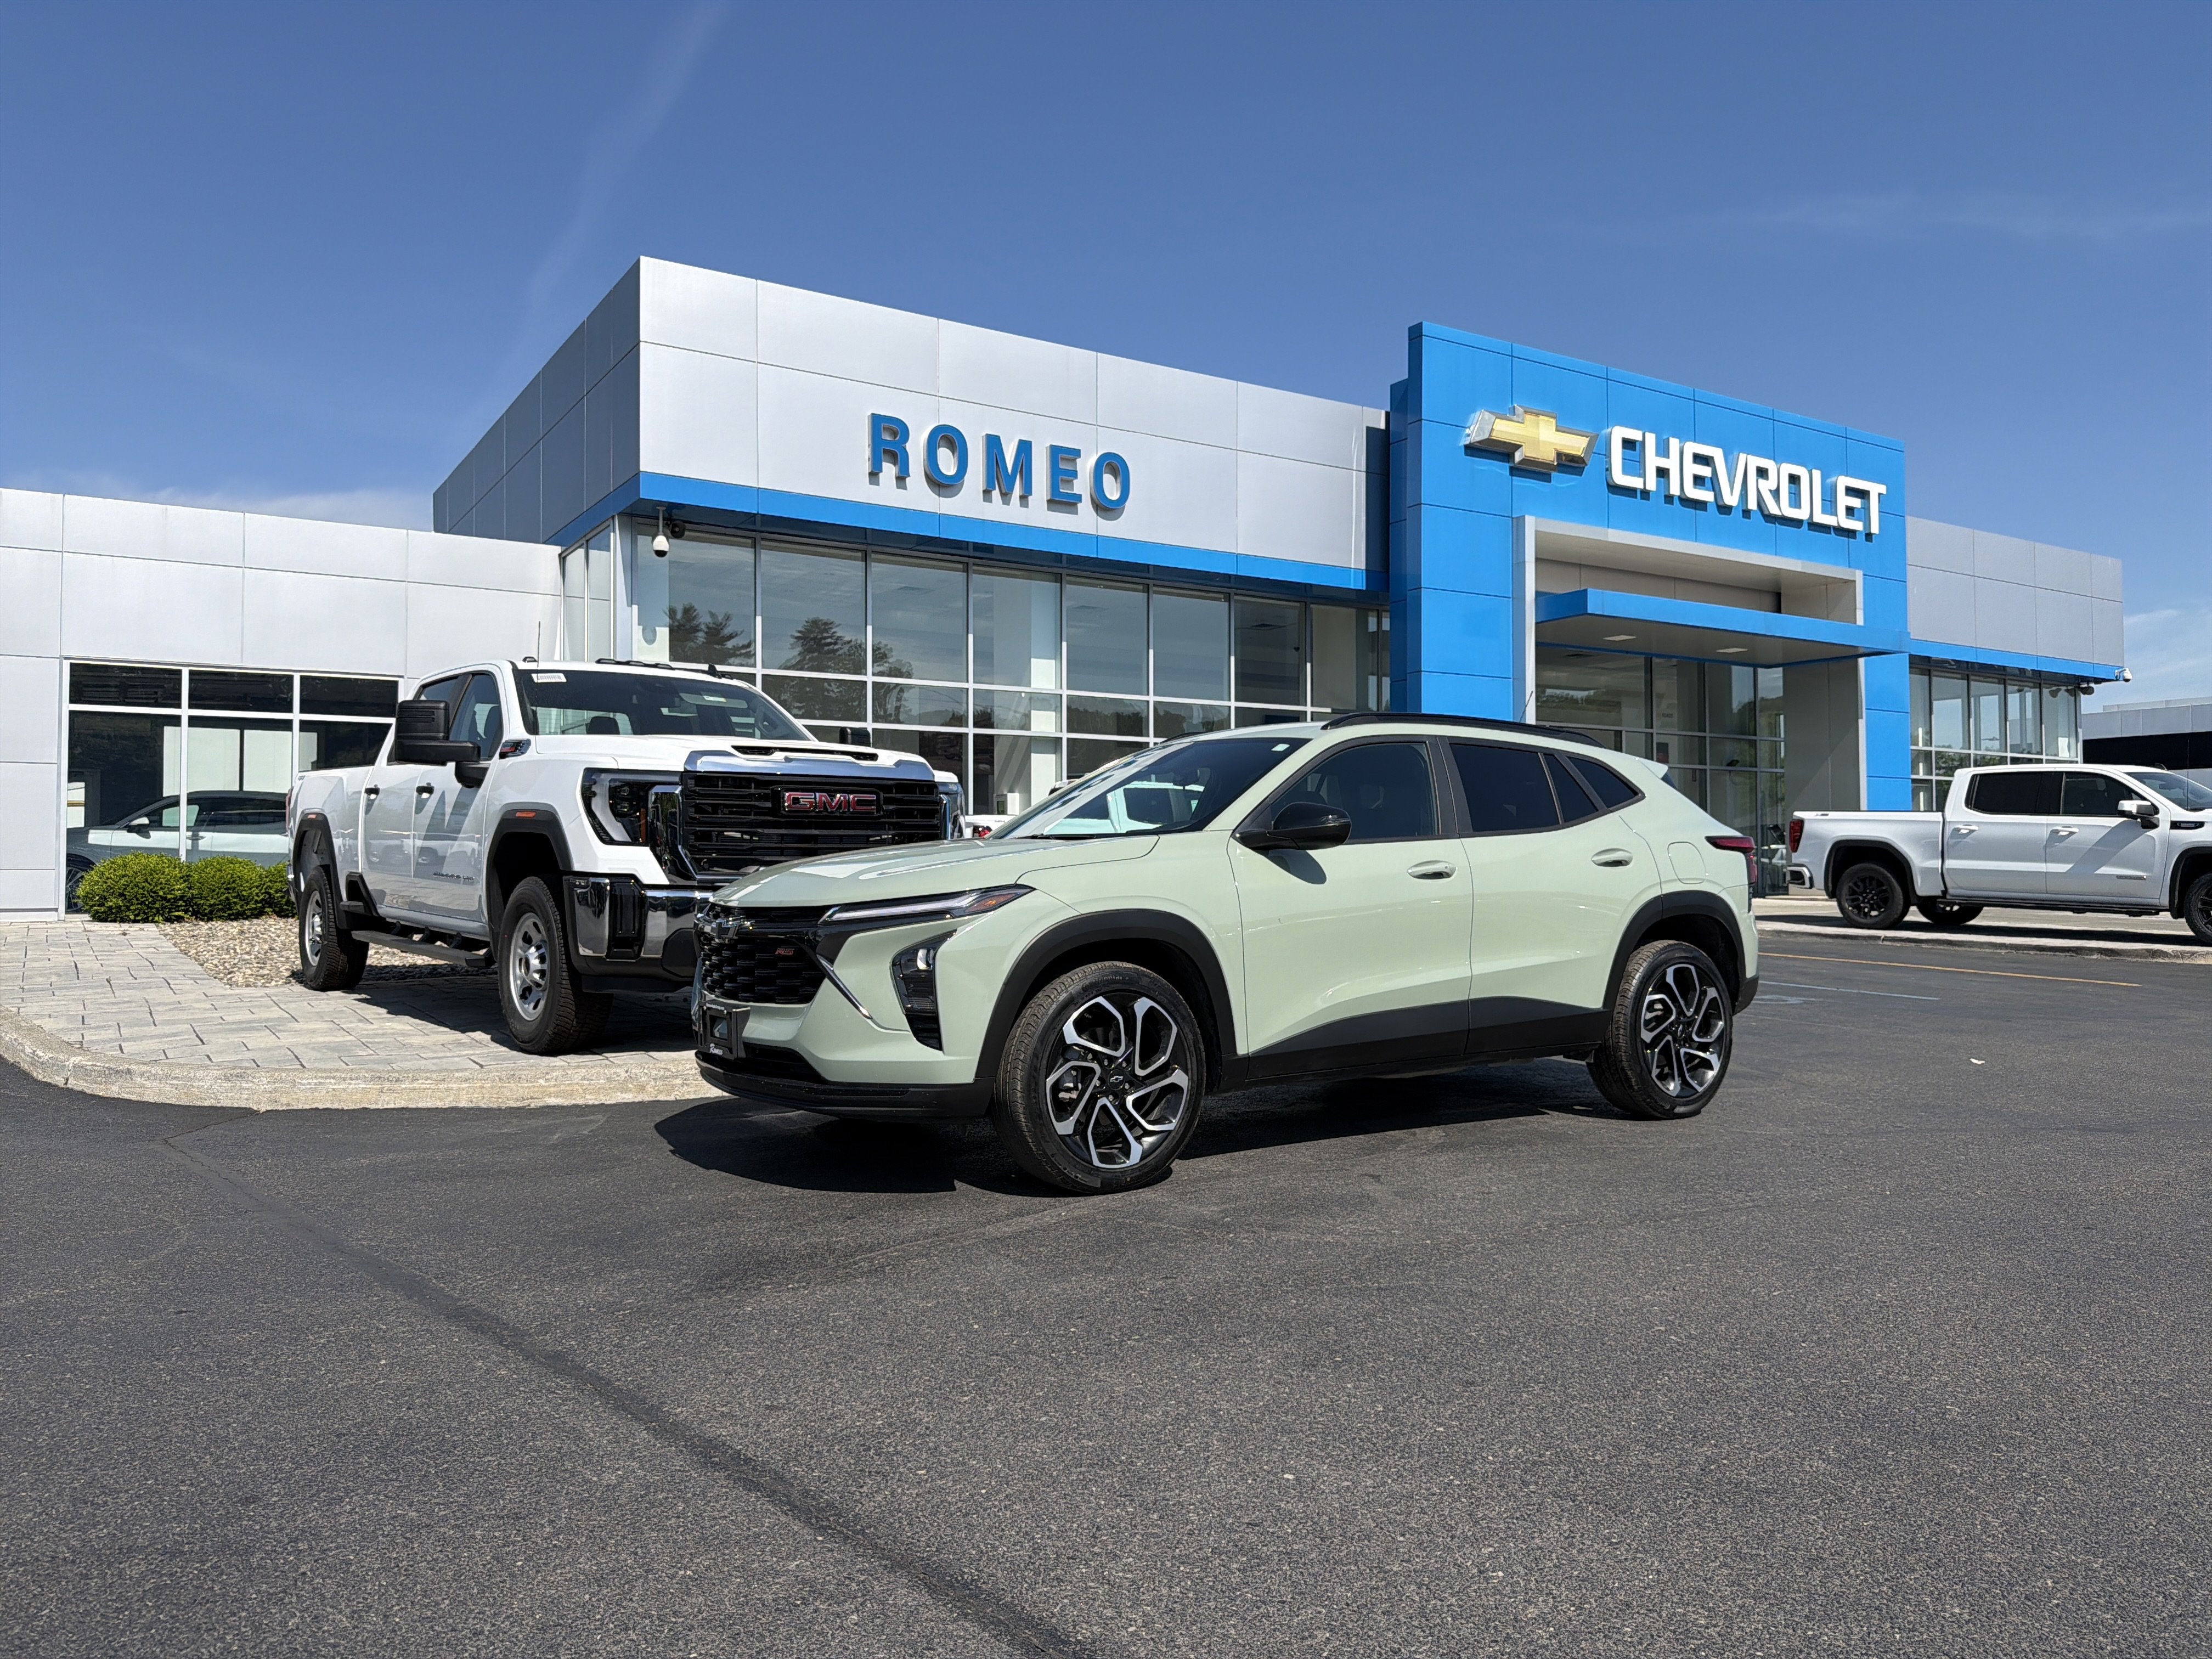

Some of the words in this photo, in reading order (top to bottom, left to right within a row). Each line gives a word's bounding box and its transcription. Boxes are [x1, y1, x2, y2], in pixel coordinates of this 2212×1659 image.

[868, 413, 1130, 509] ROMEO
[1606, 426, 1886, 534] CHEVROLET
[784, 792, 877, 812] GMC
